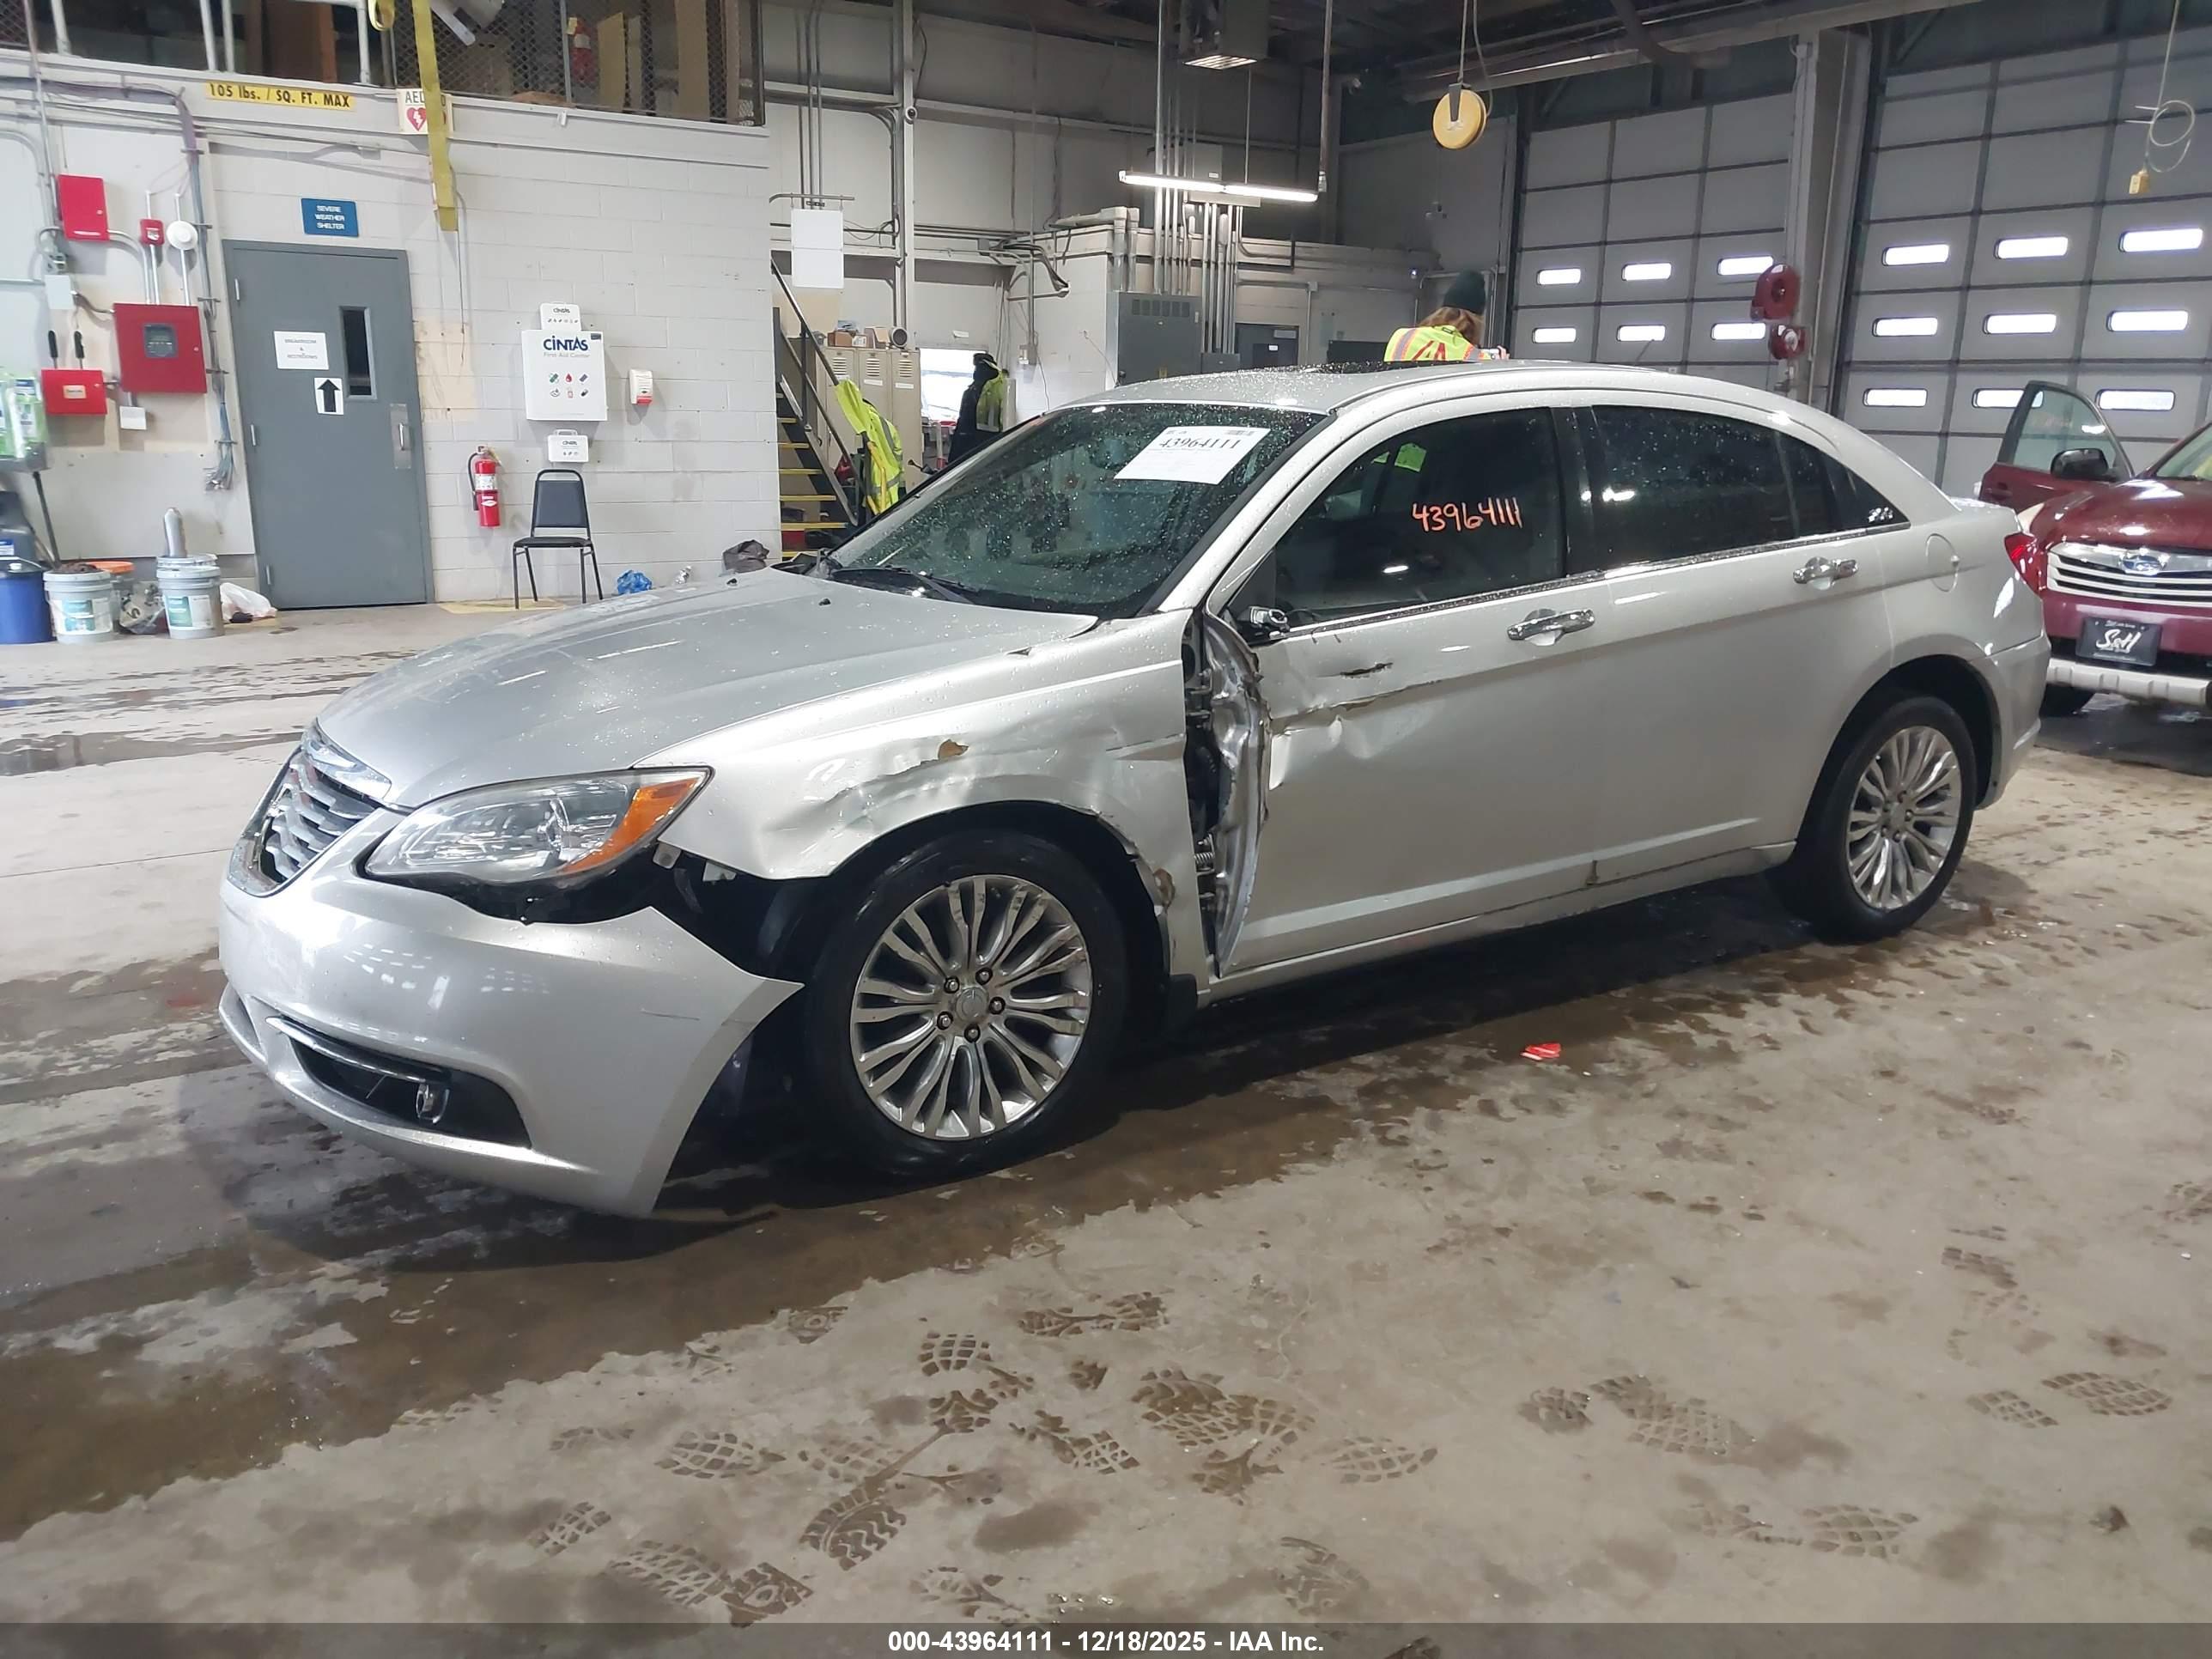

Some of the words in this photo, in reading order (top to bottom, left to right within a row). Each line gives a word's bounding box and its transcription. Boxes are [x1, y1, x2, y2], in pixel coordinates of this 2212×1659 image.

[210, 82, 233, 97] 105
[238, 85, 261, 100] lbs.
[276, 89, 295, 103] SQ.
[301, 92, 318, 105] FT.
[323, 94, 349, 107] MAX
[1159, 437, 1242, 449] 43964111
[1412, 496, 1523, 532] 43964111
